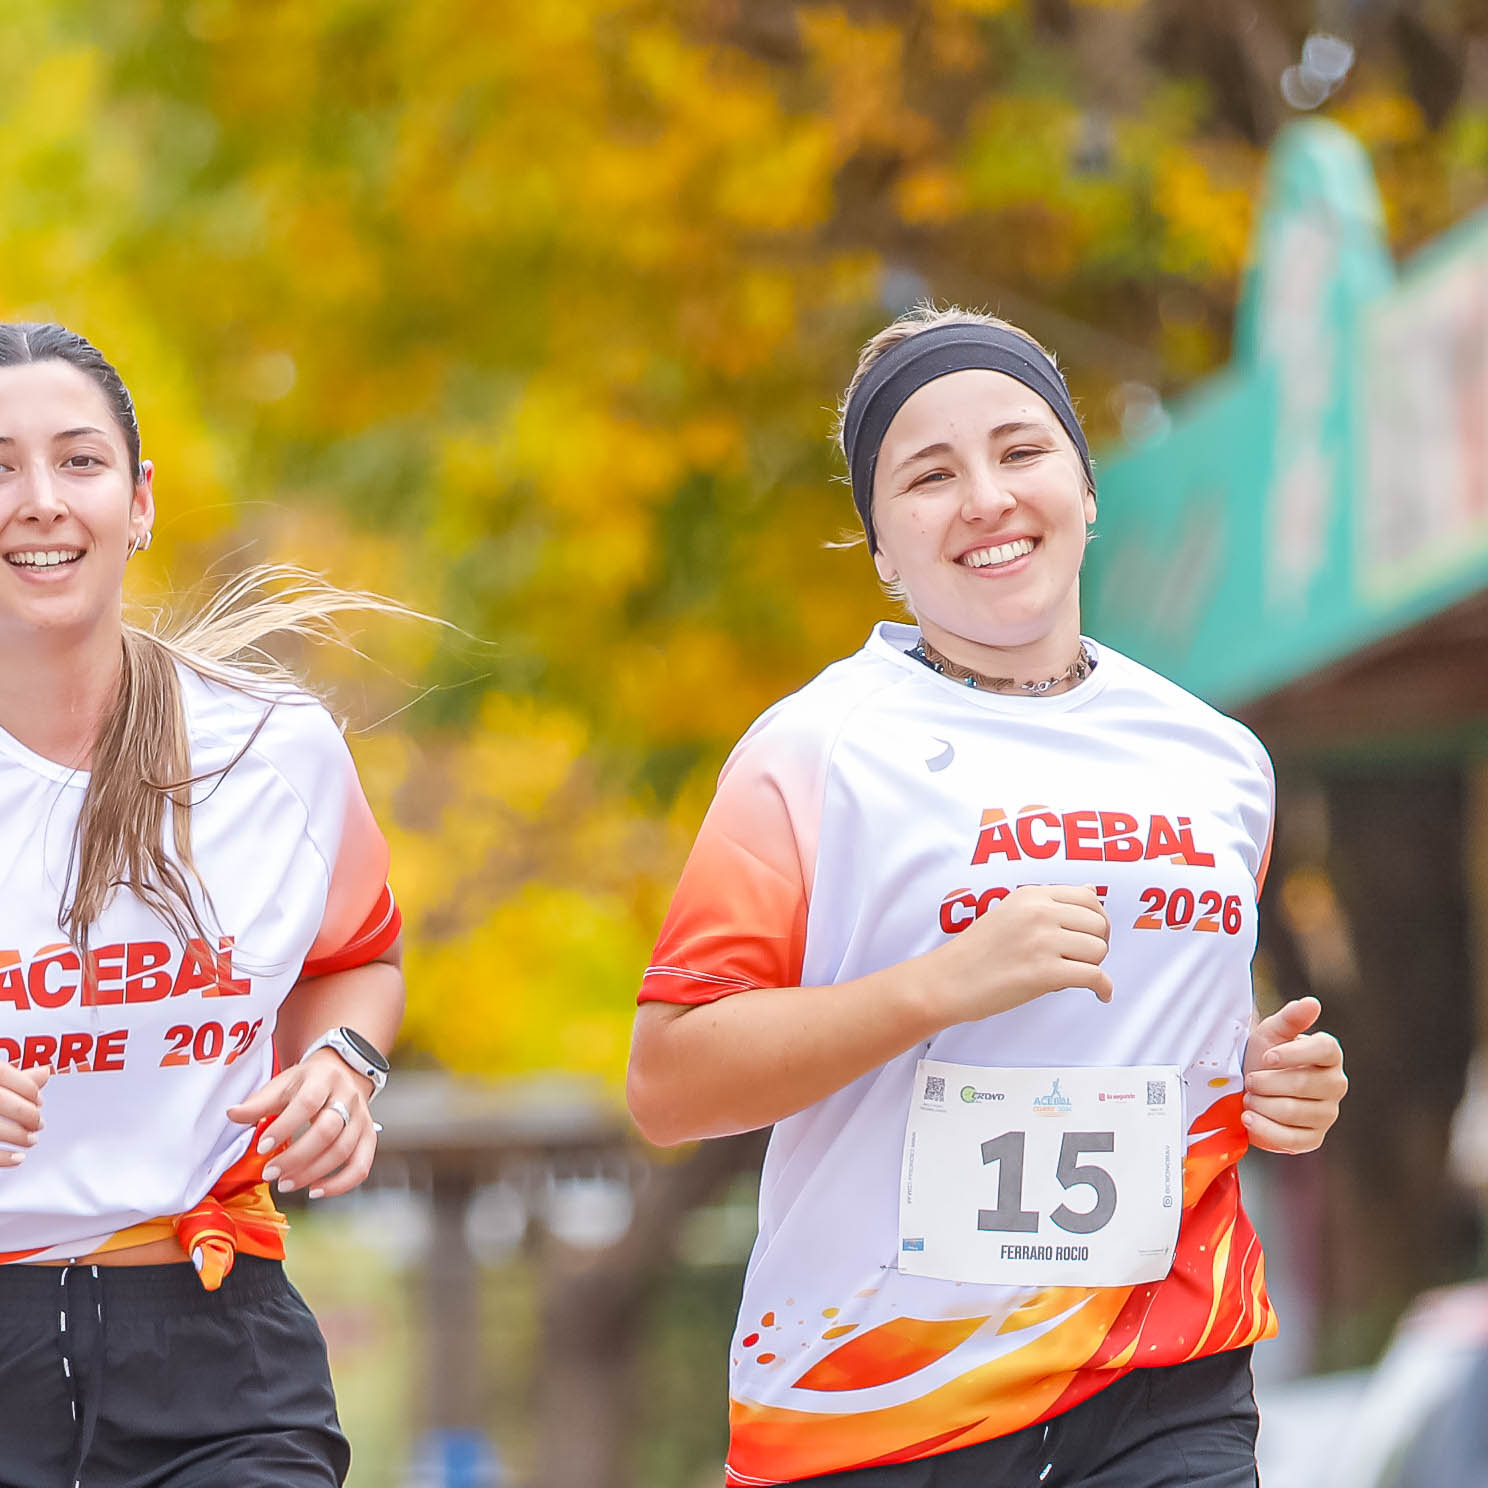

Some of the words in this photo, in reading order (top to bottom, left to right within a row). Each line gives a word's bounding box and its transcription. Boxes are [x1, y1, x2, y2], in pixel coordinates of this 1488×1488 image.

[970, 804, 1215, 867] ACEBAL
[1132, 887, 1242, 935] 2026
[977, 1131, 1117, 1234] 15
[1000, 1245, 1053, 1260] FERRARO
[1055, 1246, 1089, 1261] ROCIO
